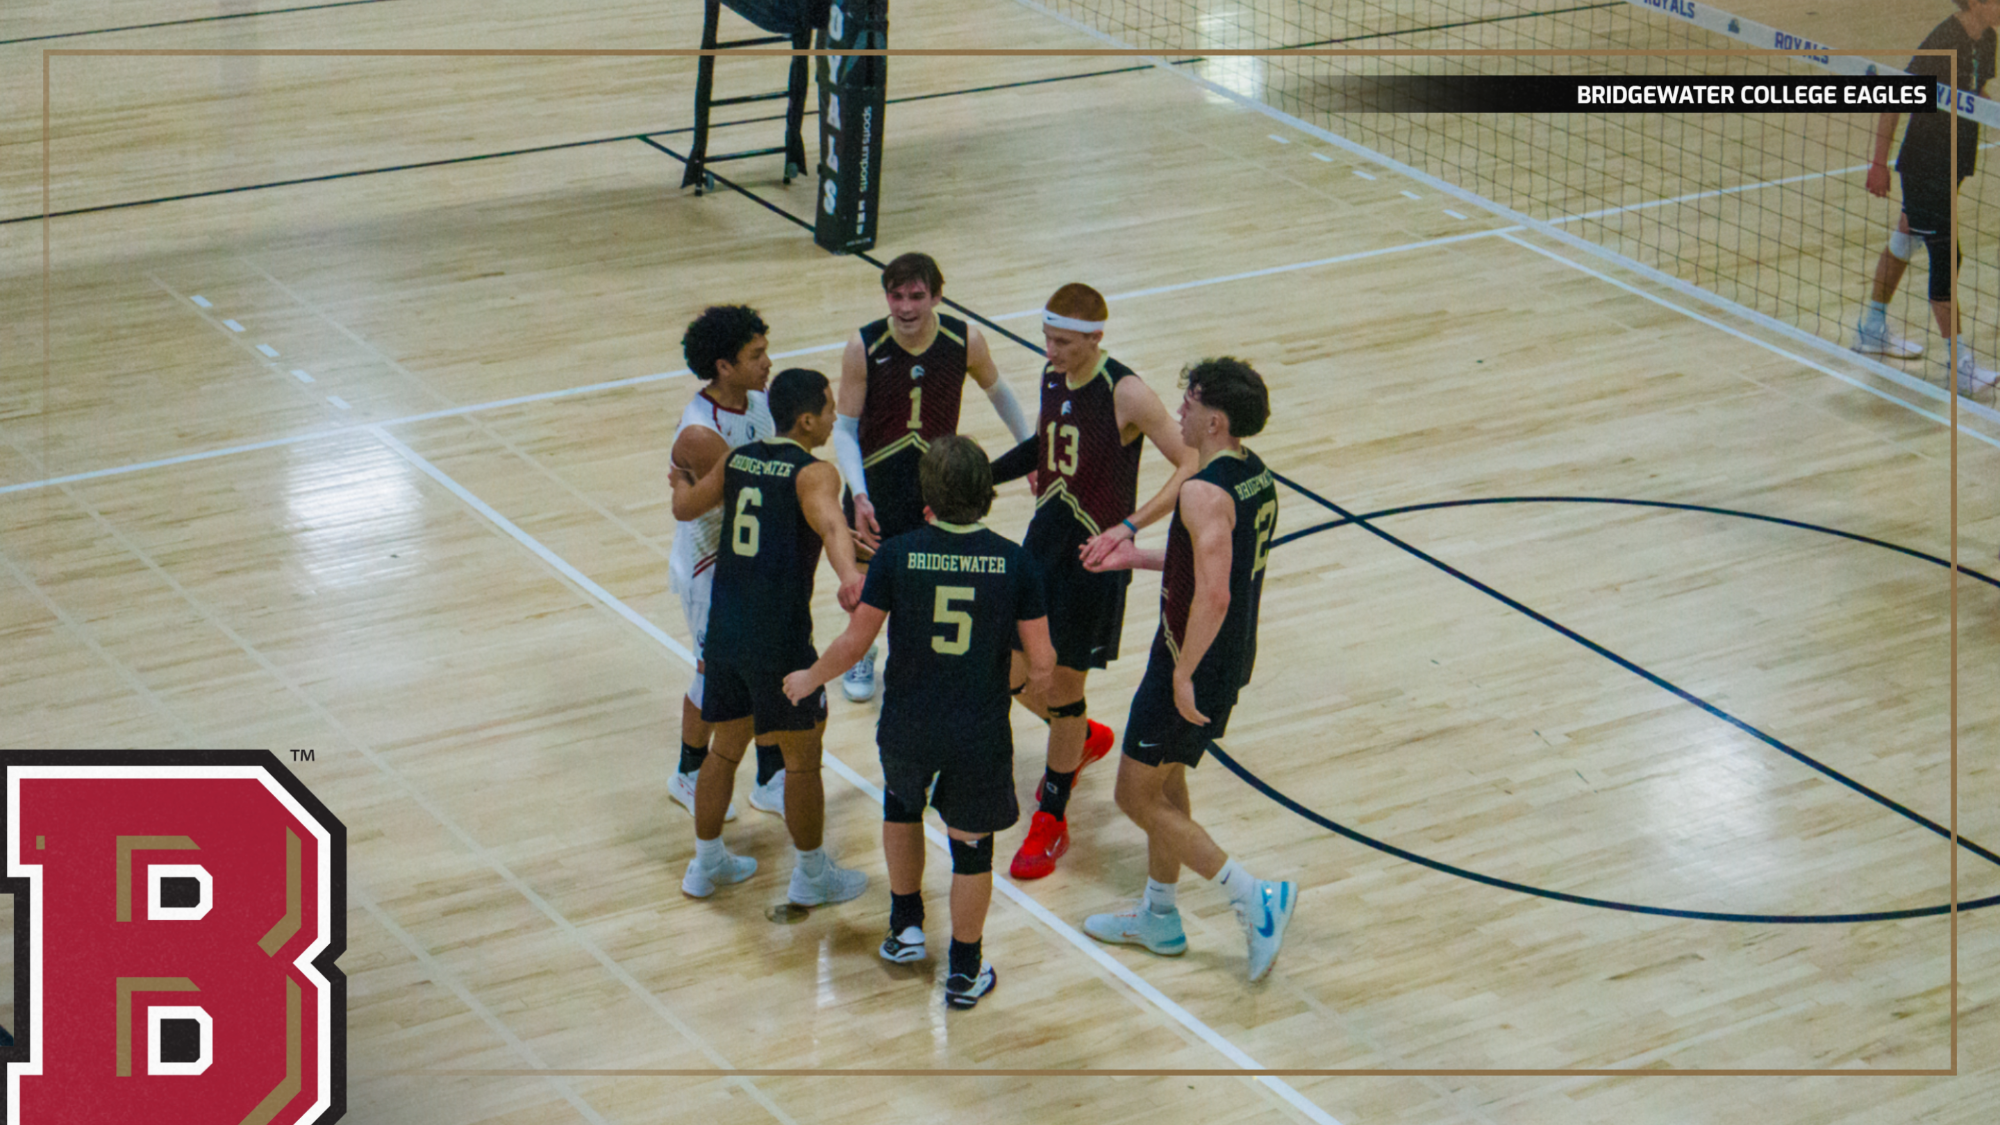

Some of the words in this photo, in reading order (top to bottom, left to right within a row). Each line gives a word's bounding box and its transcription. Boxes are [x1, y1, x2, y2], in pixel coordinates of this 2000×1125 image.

[862, 105, 872, 145] sports
[906, 386, 922, 430] 1
[1045, 421, 1080, 477] 13
[732, 486, 762, 558] 6
[907, 552, 1006, 574] BRIDGEWATER
[931, 585, 976, 656] 5
